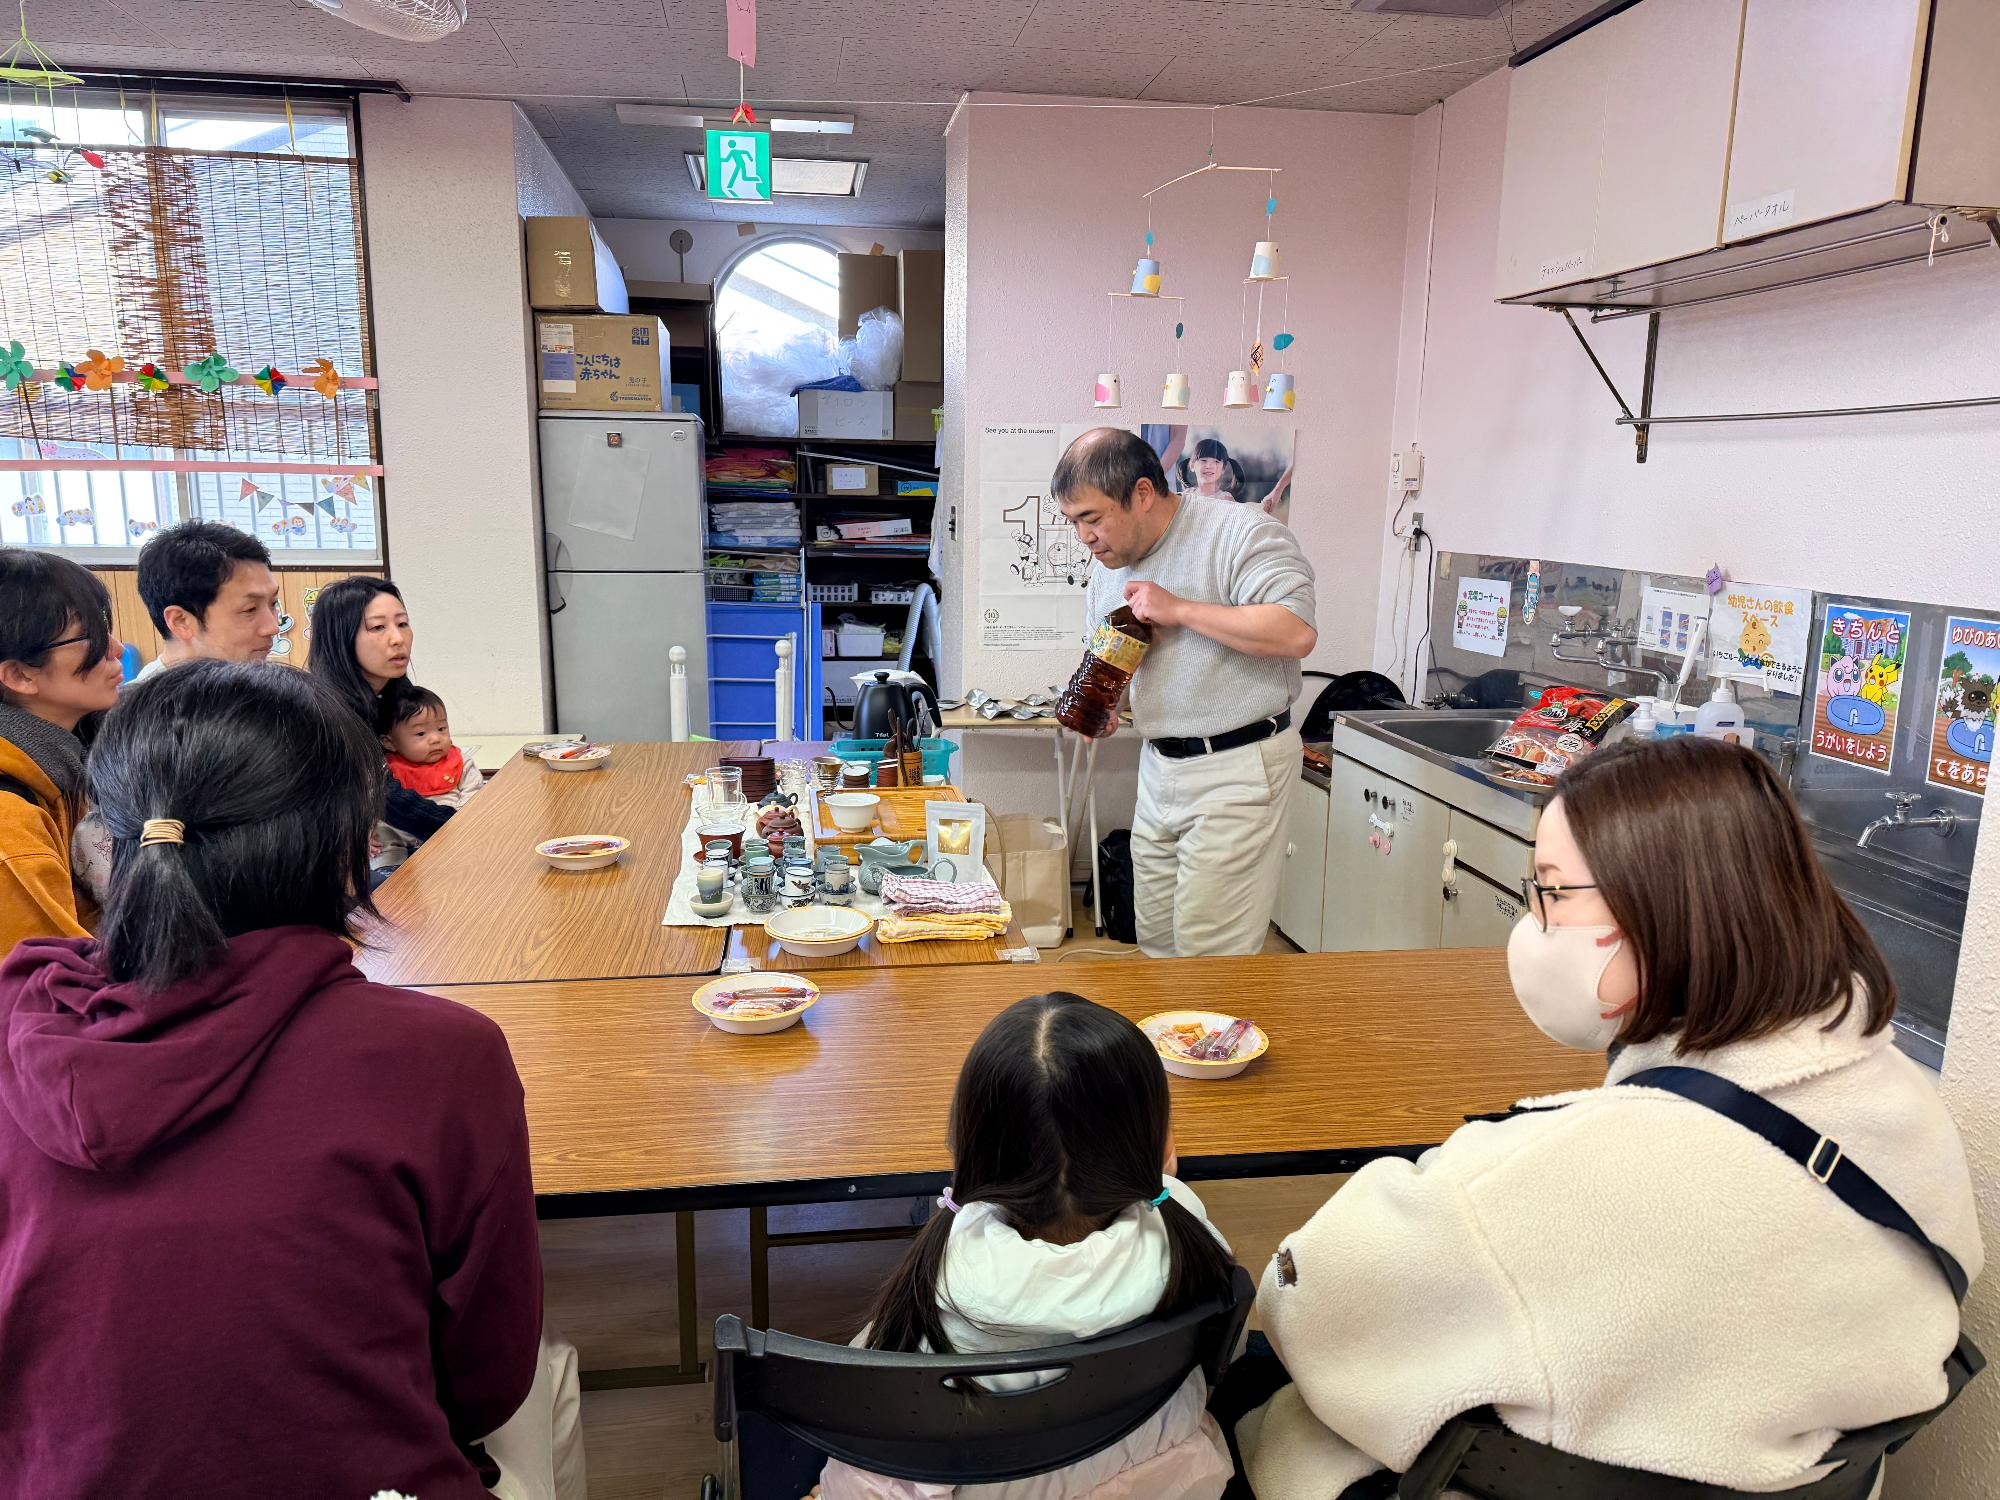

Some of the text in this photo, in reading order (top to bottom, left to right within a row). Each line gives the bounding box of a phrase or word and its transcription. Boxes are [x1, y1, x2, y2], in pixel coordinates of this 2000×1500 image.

[575, 353, 621, 369] こんにちは
[579, 367, 620, 381] 赤ちゃん
[985, 426, 997, 434] See
[997, 427, 1009, 435] you
[1727, 594, 1795, 616] 幼児さんの飲食
[1742, 611, 1779, 628] スペース
[1831, 617, 1901, 644] きちんと
[1815, 730, 1888, 763] うがいをしよう
